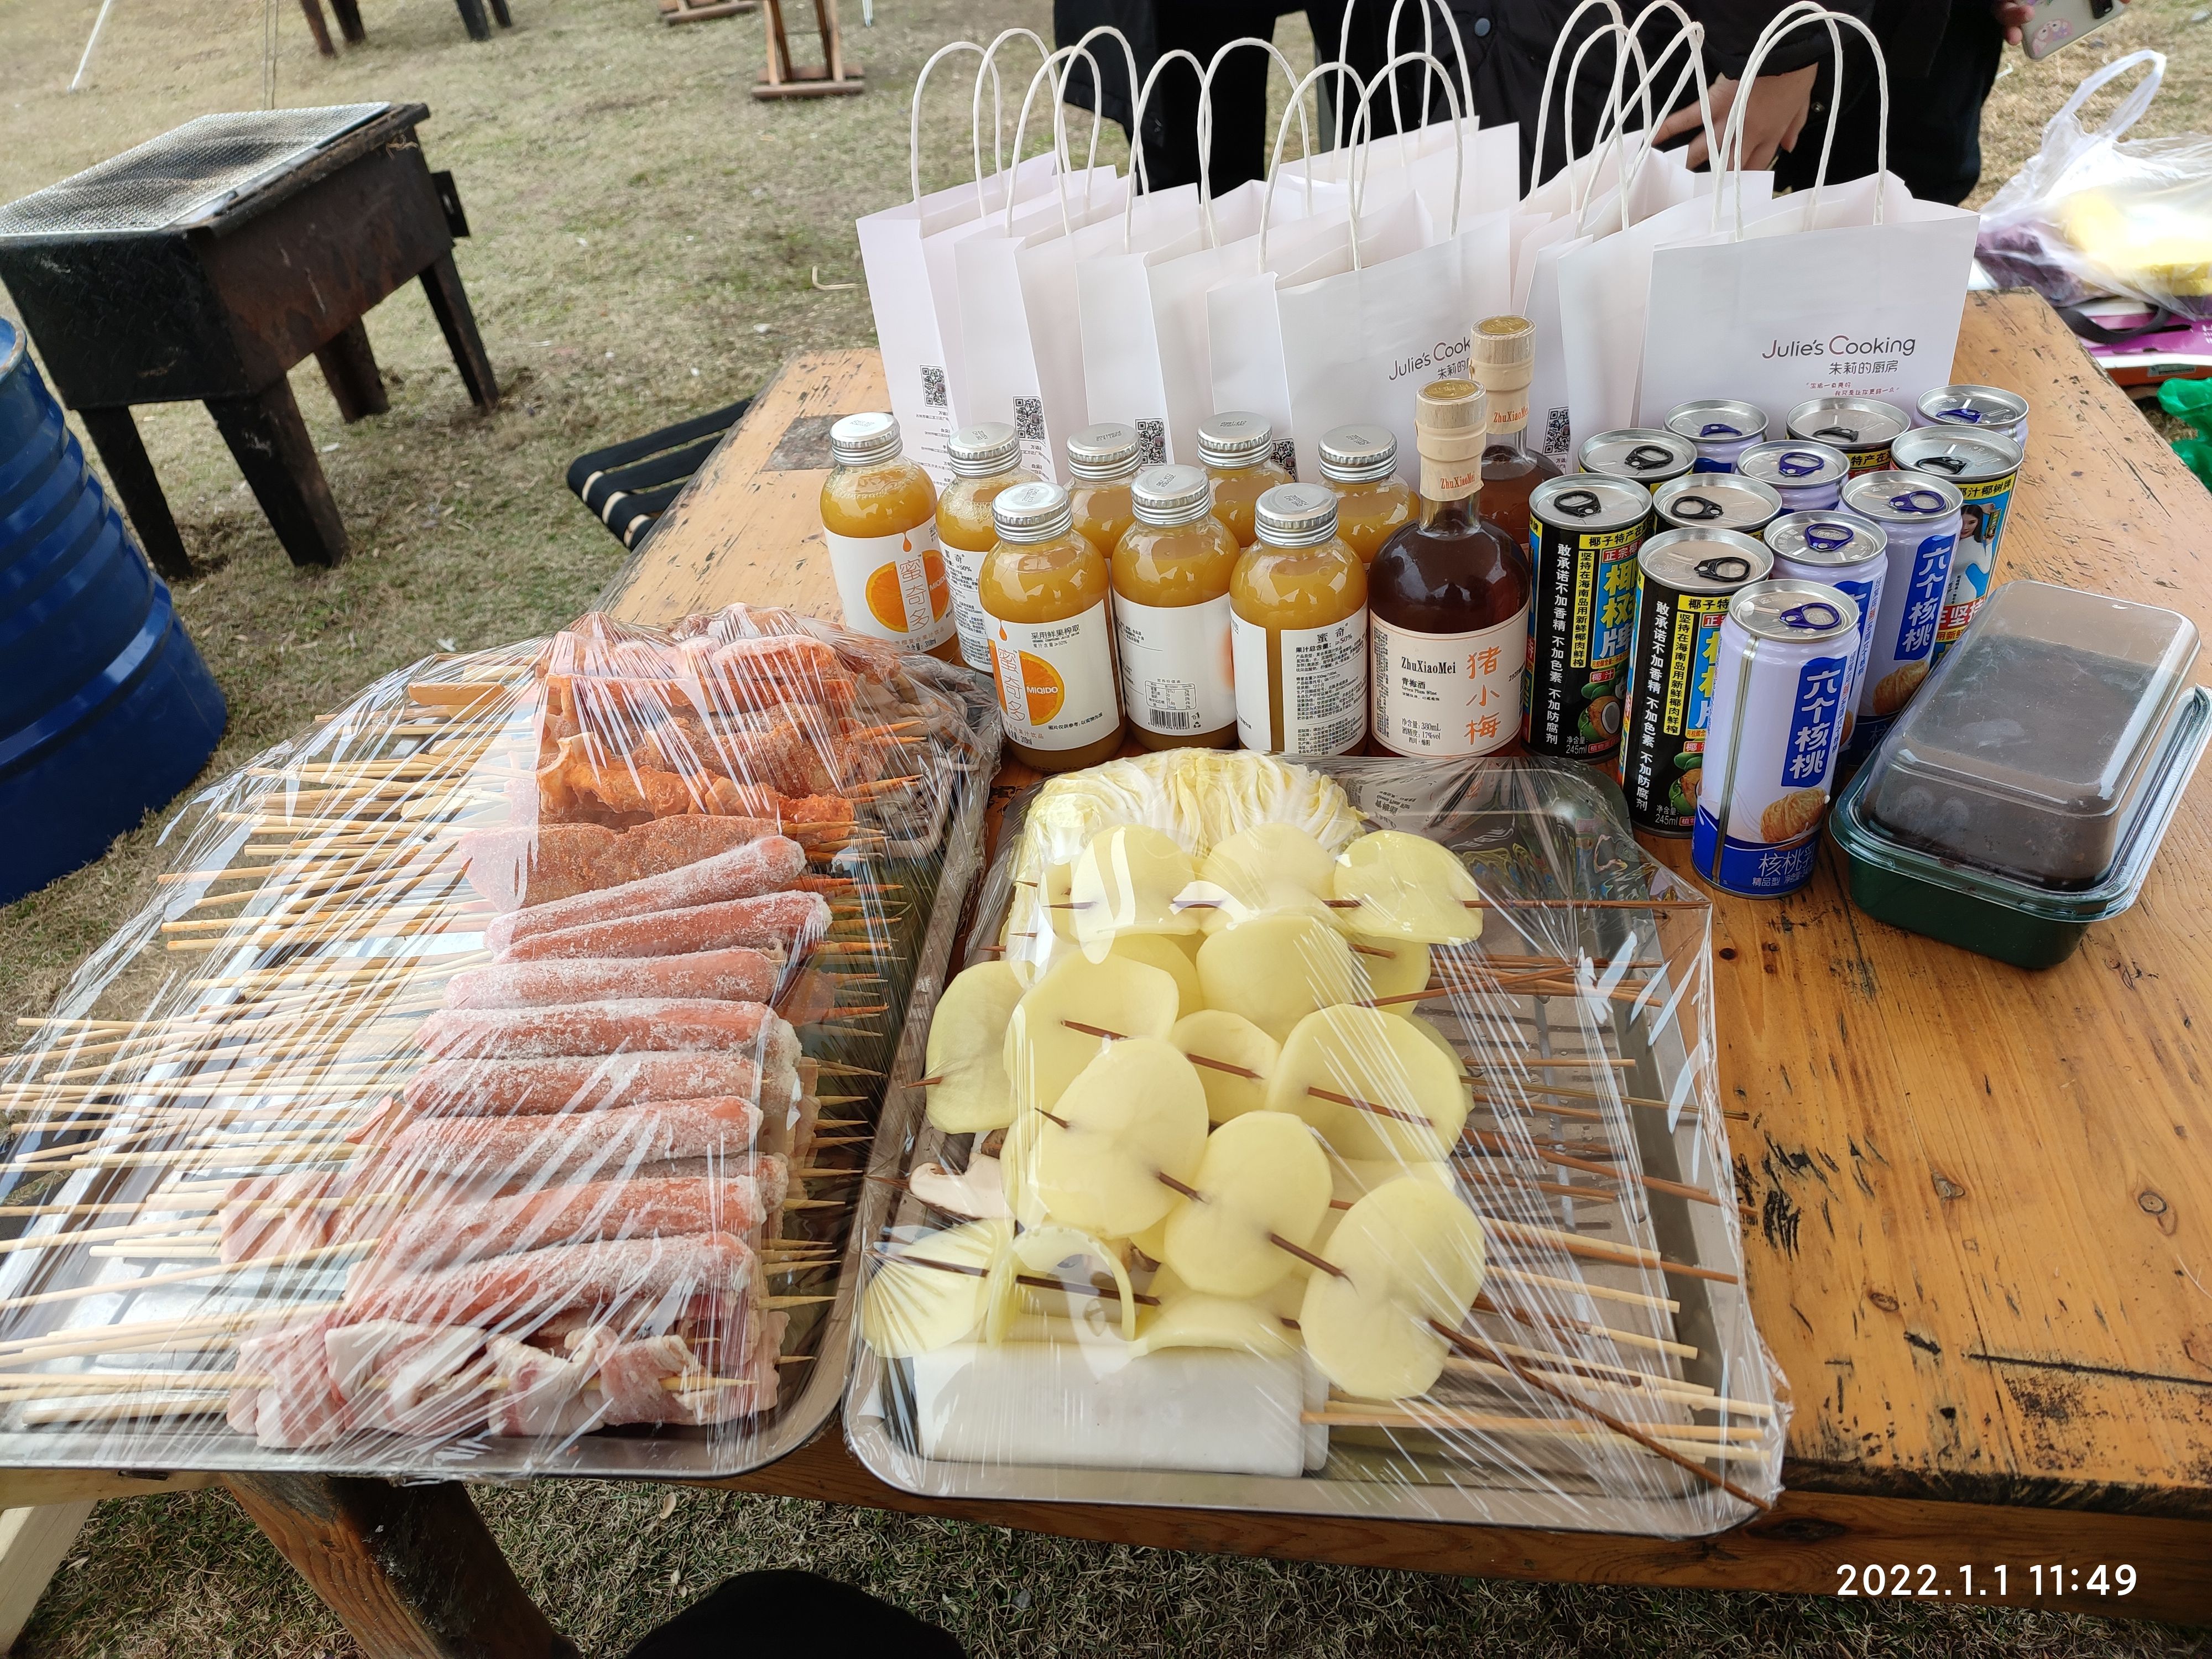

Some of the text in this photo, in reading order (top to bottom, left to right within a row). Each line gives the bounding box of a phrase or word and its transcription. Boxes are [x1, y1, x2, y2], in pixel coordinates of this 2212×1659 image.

[1762, 335, 1916, 359] Julie's Cooking
[1389, 352, 1431, 380] Julie's
[1828, 359, 1899, 375] 朱莉的厨房
[1440, 471, 1475, 490] ZhuXiaoMei
[899, 559, 930, 632] 蜜奇多
[1902, 545, 1951, 653] 六个核桃
[1546, 543, 1572, 745] 敢承诺不加香精 不加色素 不加防腐剂
[1401, 656, 1456, 674] ZhuXiaoMei
[1401, 677, 1426, 690] 青梅酒
[1592, 671, 1614, 682] 椰汁
[1026, 686, 1058, 695] MIQIDO
[1463, 645, 1503, 745] 猪小梅
[1636, 601, 1671, 812] 敢承诺不加香精 不加色素 不加防腐剂
[1790, 670, 1841, 779] 六个核桃
[1566, 744, 1588, 754] 245ml
[1655, 814, 1678, 826] 245ml
[1752, 877, 1781, 887] 精品型
